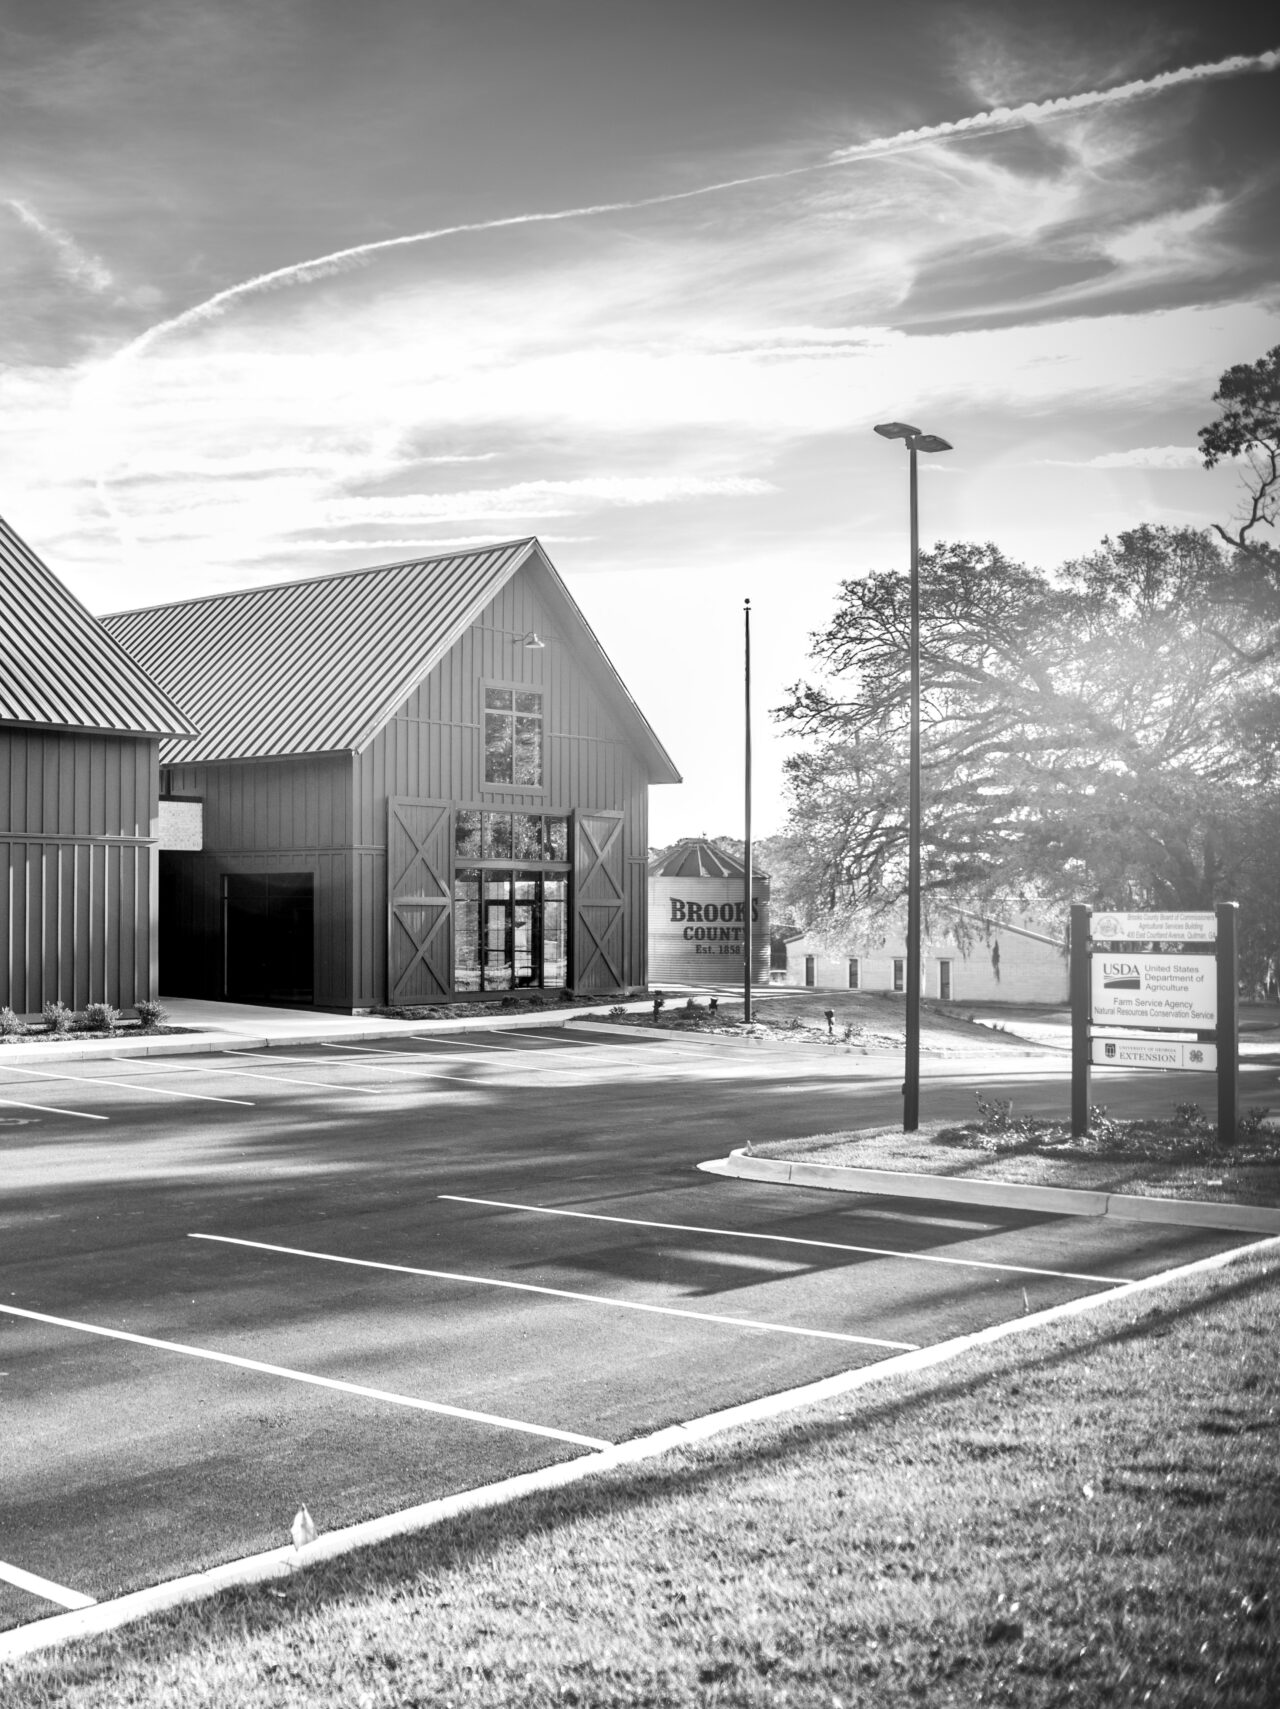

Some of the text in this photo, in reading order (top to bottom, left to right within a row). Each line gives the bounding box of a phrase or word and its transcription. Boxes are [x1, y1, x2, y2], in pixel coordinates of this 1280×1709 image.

[1185, 922, 1203, 931] Building
[683, 926, 745, 941] COUNT
[695, 944, 741, 954] Est. 1858
[1103, 963, 1140, 975] USDA
[1144, 964, 1199, 973] United States
[1144, 974, 1194, 983] Department
[1145, 983, 1189, 992] Agriculture
[1113, 997, 1193, 1009] Farm Service Agency
[1094, 1006, 1215, 1020] Natural Resources Conservation Service
[1120, 1052, 1176, 1062] EXTENSION
